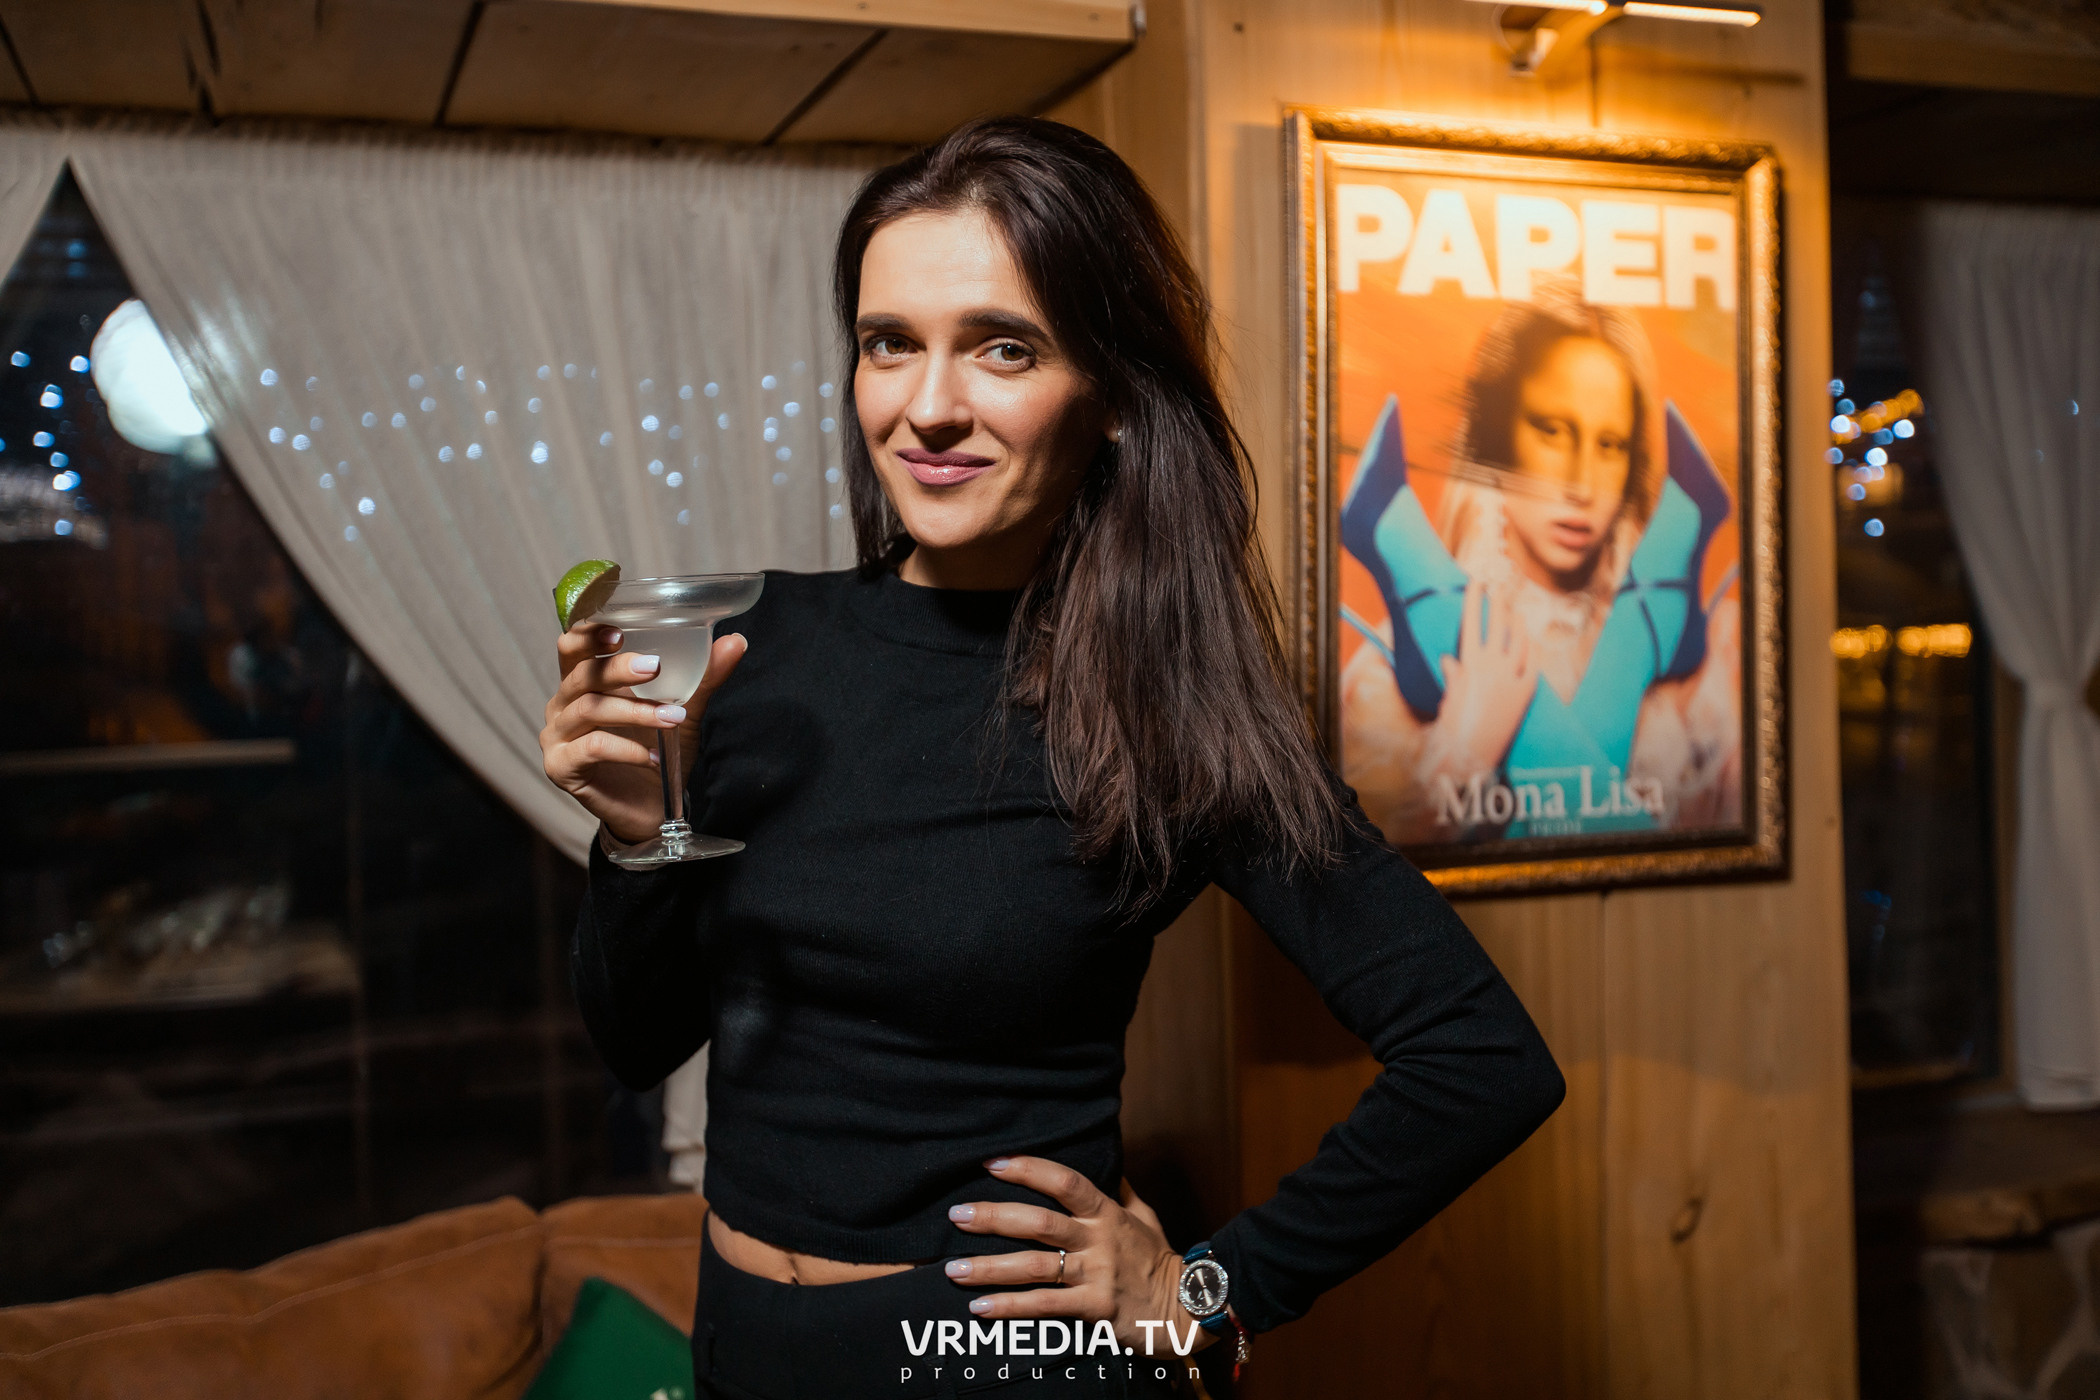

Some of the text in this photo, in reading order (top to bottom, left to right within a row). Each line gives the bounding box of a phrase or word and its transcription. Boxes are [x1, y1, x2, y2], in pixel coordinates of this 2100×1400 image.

[1336, 184, 1735, 310] PAPER
[1436, 765, 1666, 826] Mona Lisa
